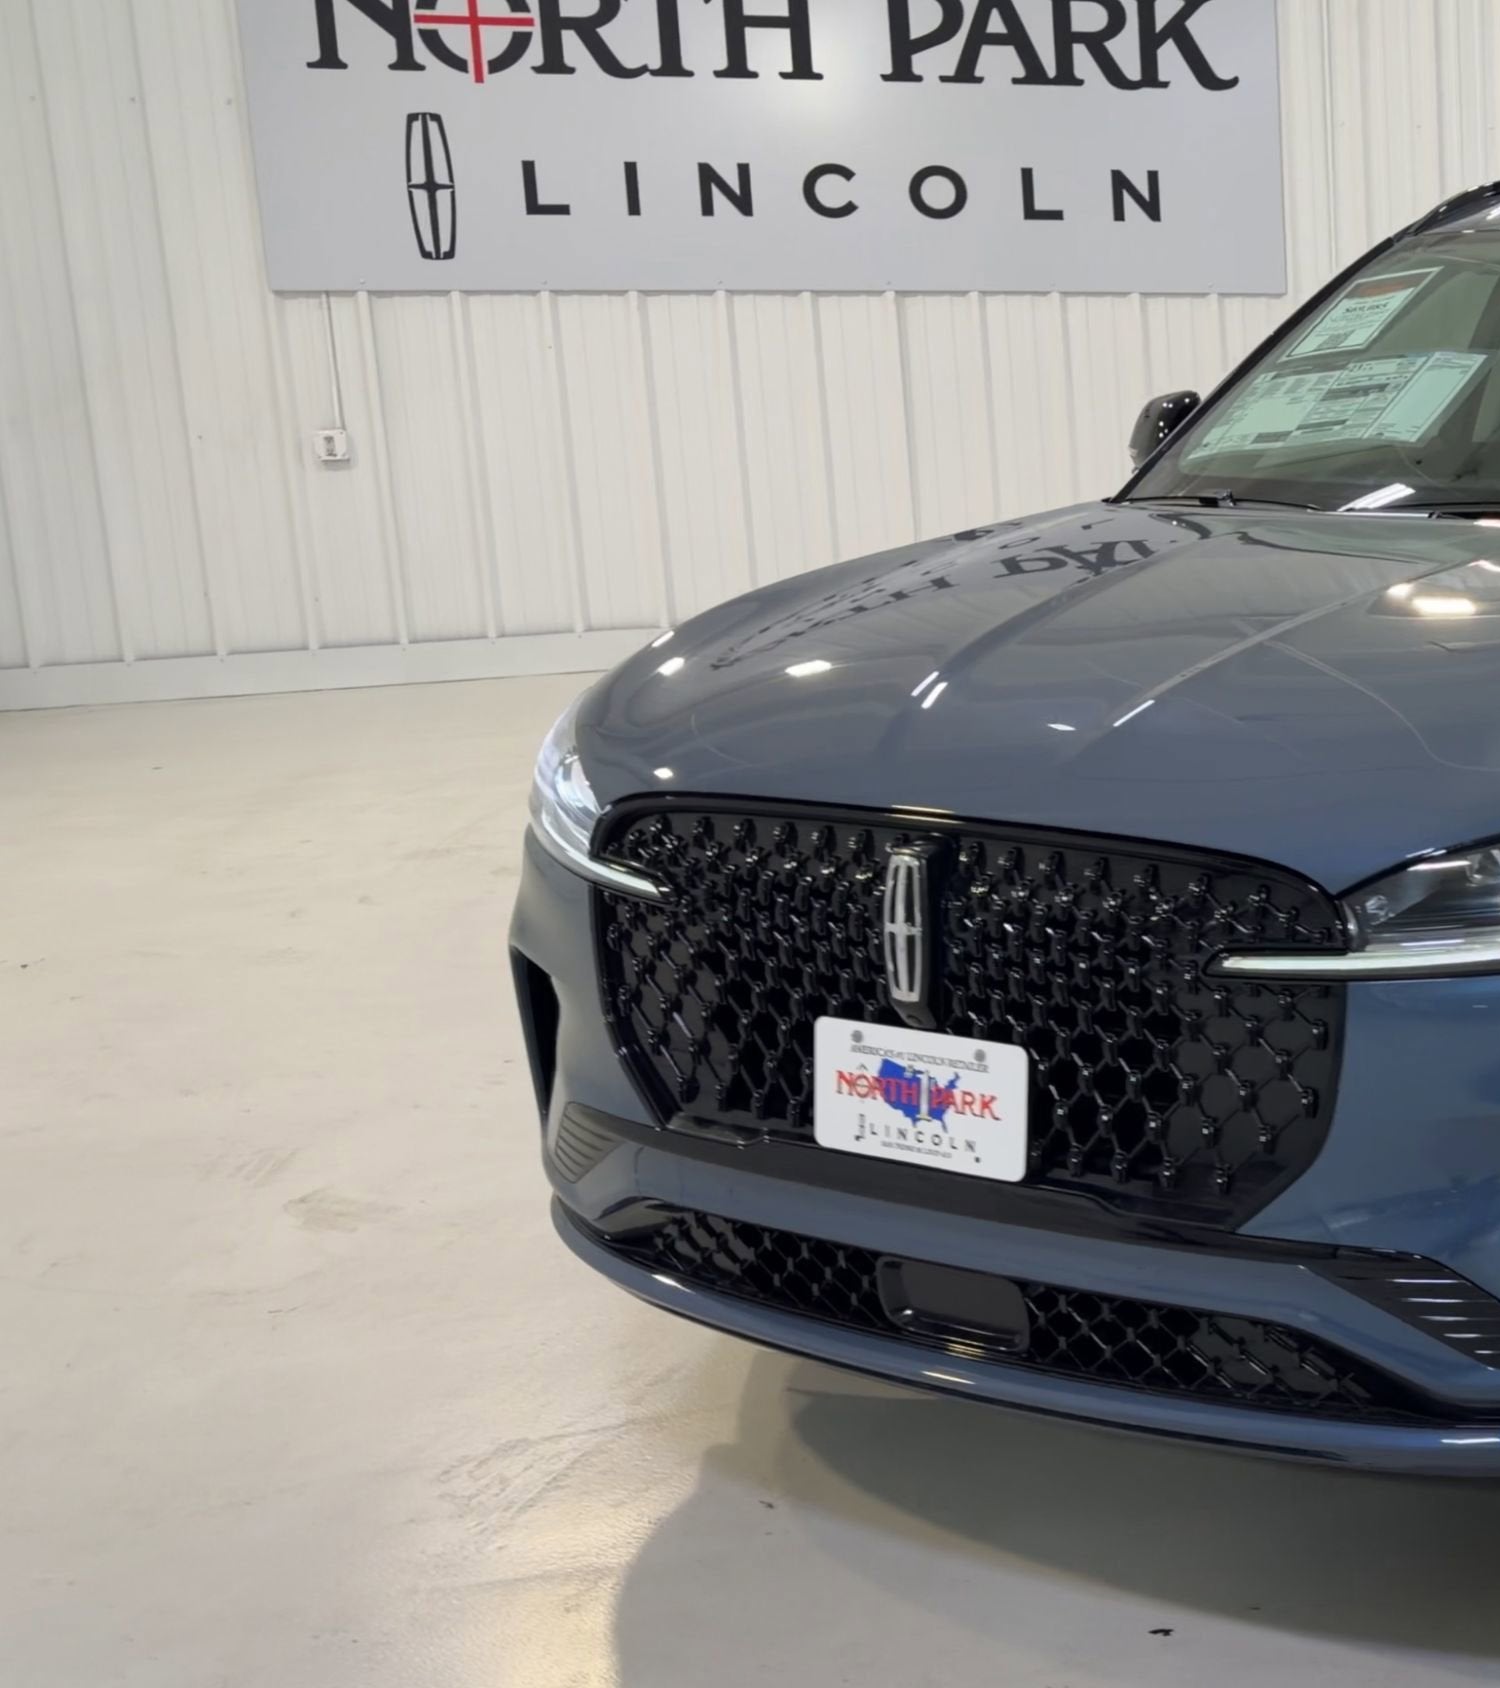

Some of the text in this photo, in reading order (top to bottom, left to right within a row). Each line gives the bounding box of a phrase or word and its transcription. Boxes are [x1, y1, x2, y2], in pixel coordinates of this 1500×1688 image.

[306, 0, 1239, 91] NORTH PARK
[521, 160, 1161, 222] LINCOLN
[836, 1070, 1002, 1121] NORTH PARK
[869, 1123, 976, 1153] LINCOLN
